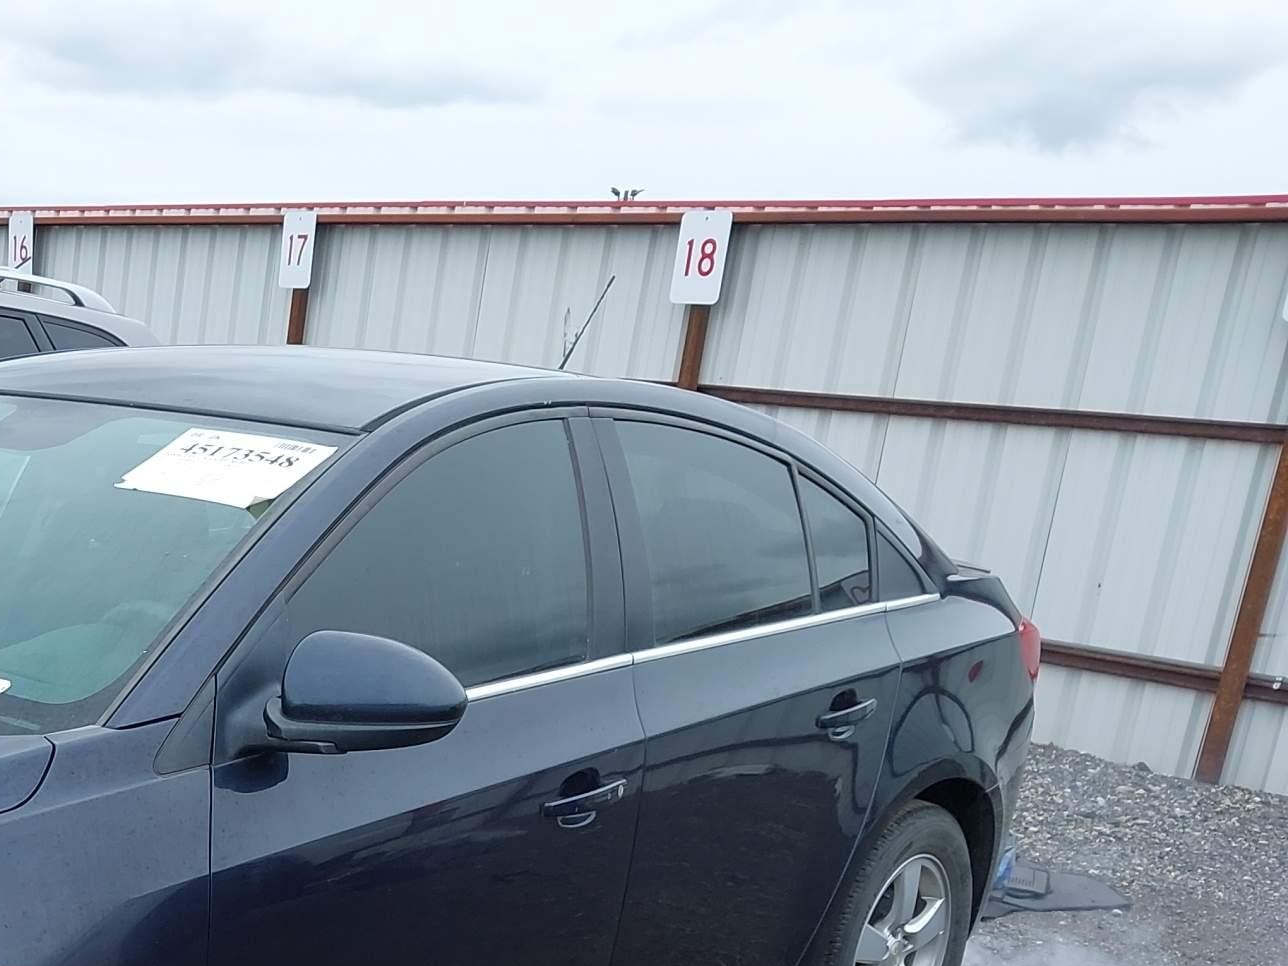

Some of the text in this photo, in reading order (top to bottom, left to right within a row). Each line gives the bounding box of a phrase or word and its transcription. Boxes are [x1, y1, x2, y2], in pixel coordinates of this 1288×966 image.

[13, 235, 29, 262] 16
[287, 233, 309, 267] 17
[684, 238, 718, 277] 18
[180, 441, 300, 469] 45173548
